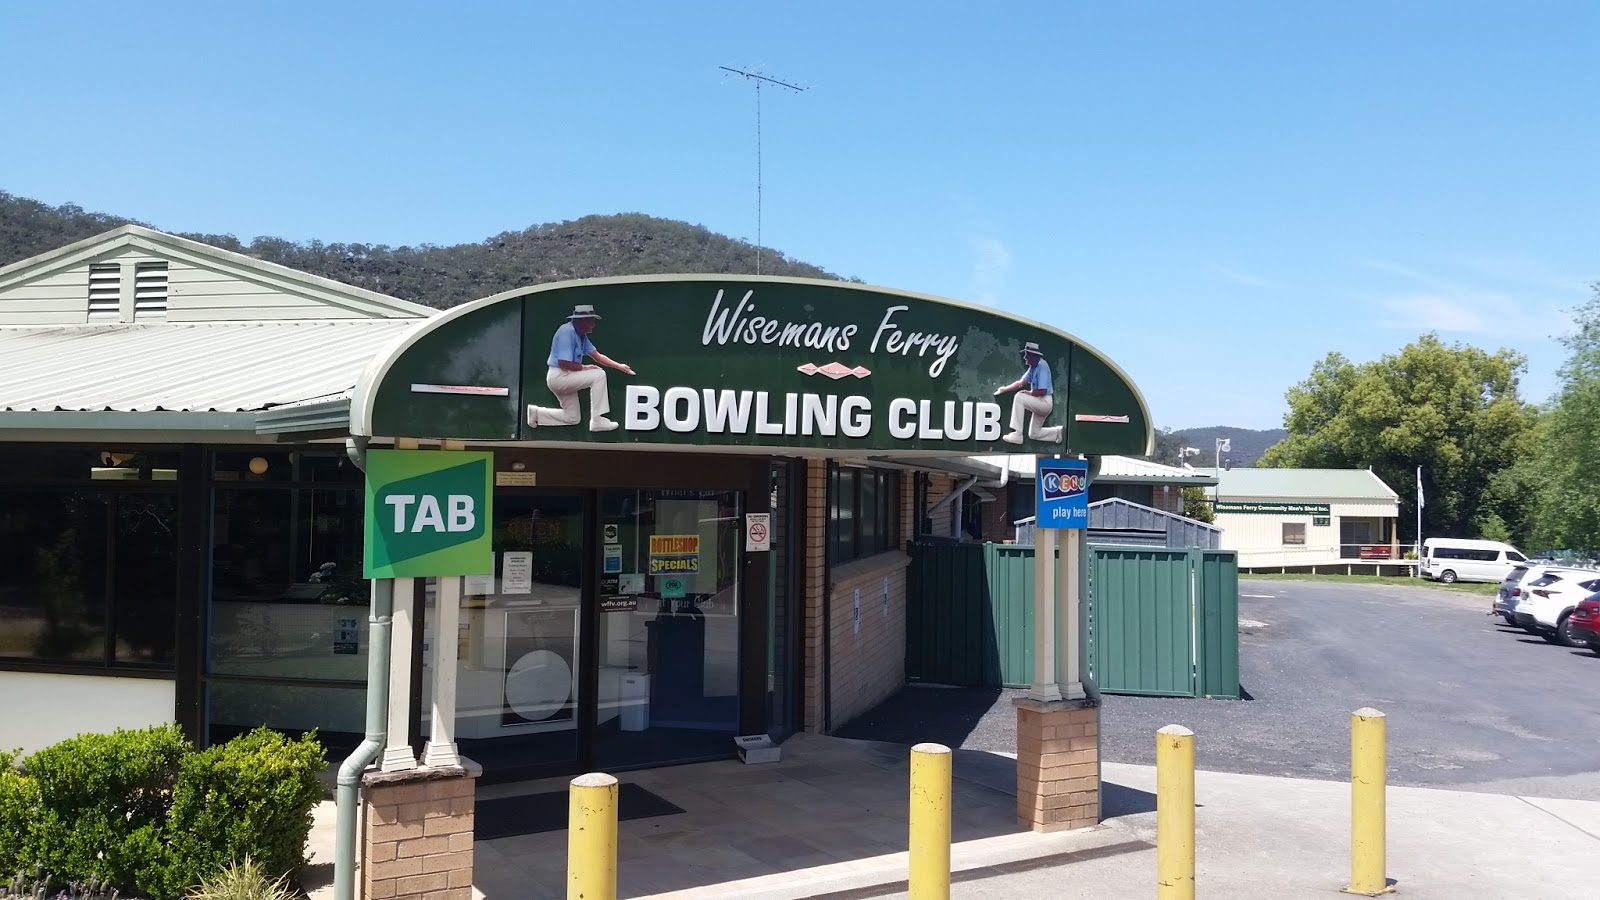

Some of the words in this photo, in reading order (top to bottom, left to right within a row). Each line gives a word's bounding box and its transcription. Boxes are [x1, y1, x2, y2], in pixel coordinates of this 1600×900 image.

[702, 289, 858, 352] Wisemans
[870, 305, 958, 378] Ferry
[625, 385, 872, 437] BOWLING
[888, 398, 1002, 441] CLUB
[1047, 475, 1084, 490] KENO
[385, 494, 475, 533] TAB
[1052, 506, 1072, 520] play
[1073, 506, 1086, 517] here
[651, 537, 698, 553] BOTTLESHOP
[651, 558, 698, 572] SPECIALS
